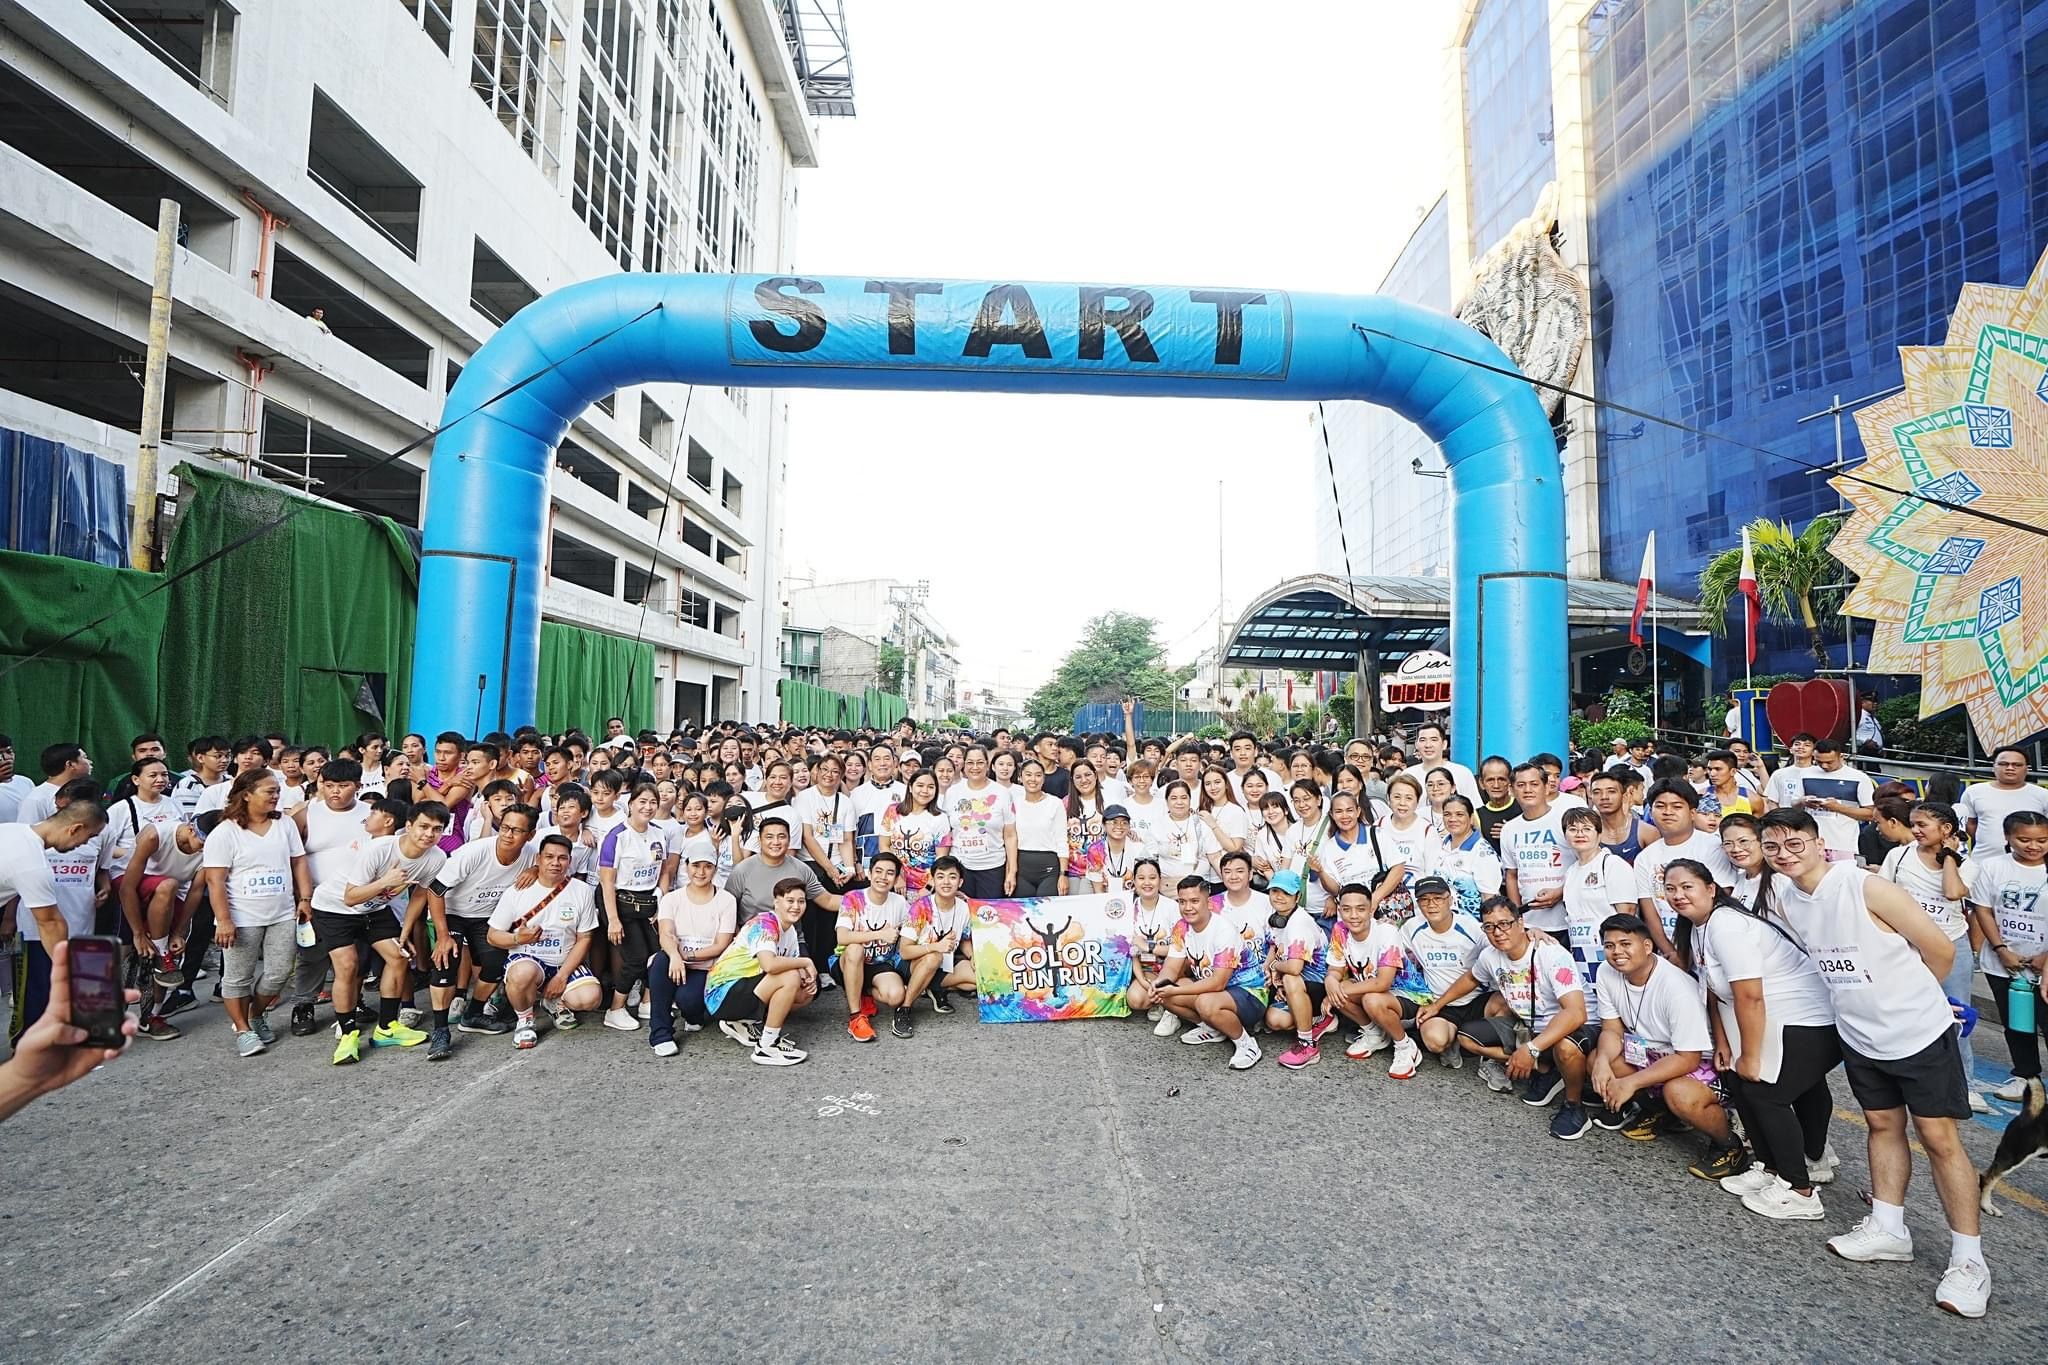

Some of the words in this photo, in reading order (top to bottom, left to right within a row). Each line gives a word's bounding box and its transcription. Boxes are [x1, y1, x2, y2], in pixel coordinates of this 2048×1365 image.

[748, 276, 1267, 366] START
[961, 839, 985, 847] 1361
[1519, 850, 1548, 860] 0869
[52, 865, 89, 875] 1306
[634, 866, 657, 878] 0997
[248, 875, 283, 887] 0160
[478, 890, 504, 899] 0307
[2000, 889, 2039, 912] 87
[1920, 902, 1945, 914] 337
[2002, 918, 2035, 933] 0601
[1005, 940, 1105, 972] COLOR
[1427, 952, 1457, 961] 0979
[1818, 959, 1856, 972] 0348
[1012, 970, 1055, 991] FUN
[1059, 964, 1106, 986] RUN
[1509, 991, 1539, 1001] 146
